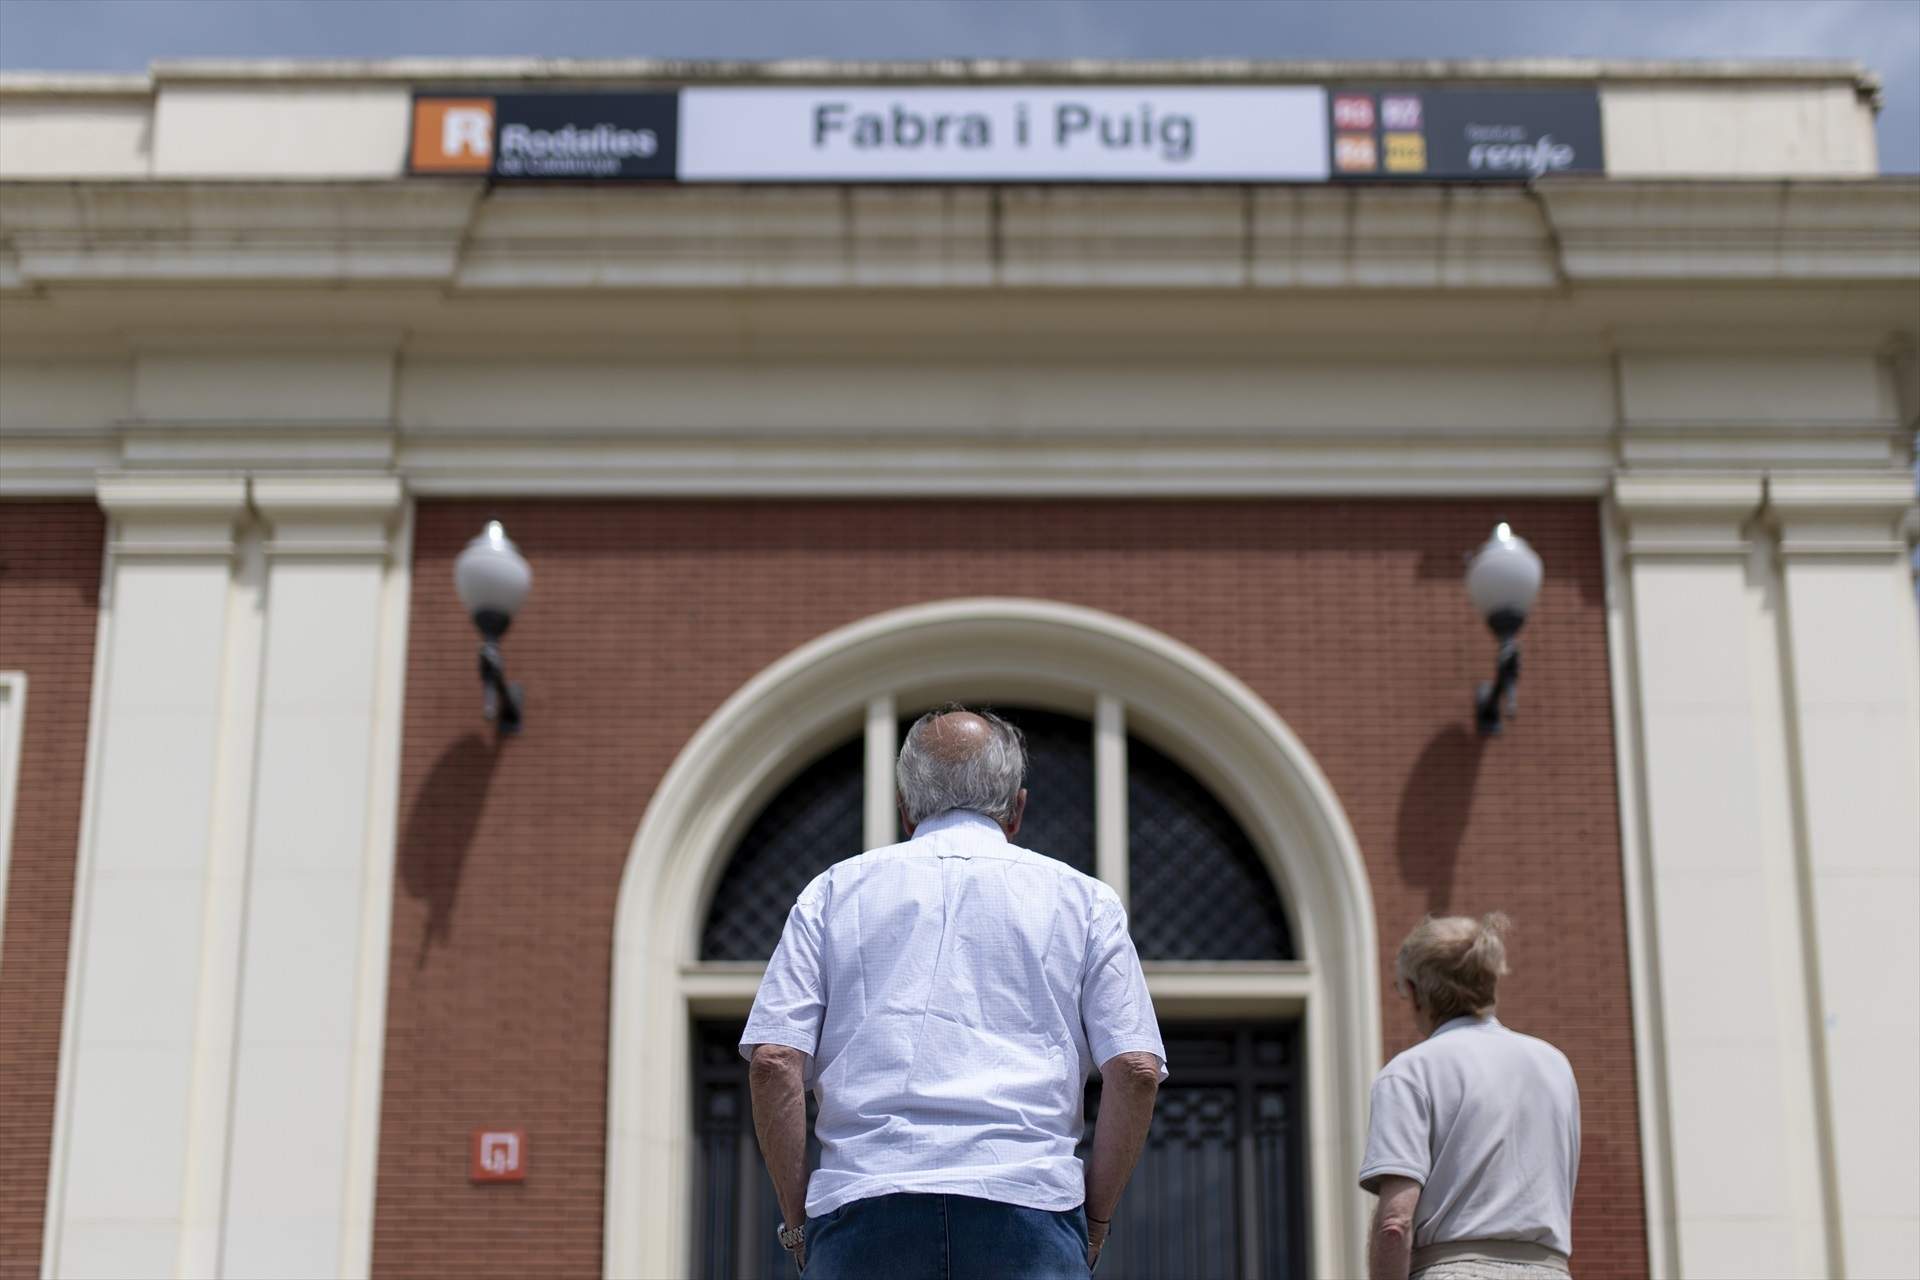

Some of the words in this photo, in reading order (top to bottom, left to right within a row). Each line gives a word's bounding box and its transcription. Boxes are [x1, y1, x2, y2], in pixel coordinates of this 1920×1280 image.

[443, 107, 492, 156] R
[502, 124, 656, 156] Rodalies
[812, 103, 992, 148] Fabra
[1014, 103, 1029, 147] i
[1055, 103, 1195, 163] Puig
[1469, 135, 1575, 177] renfe
